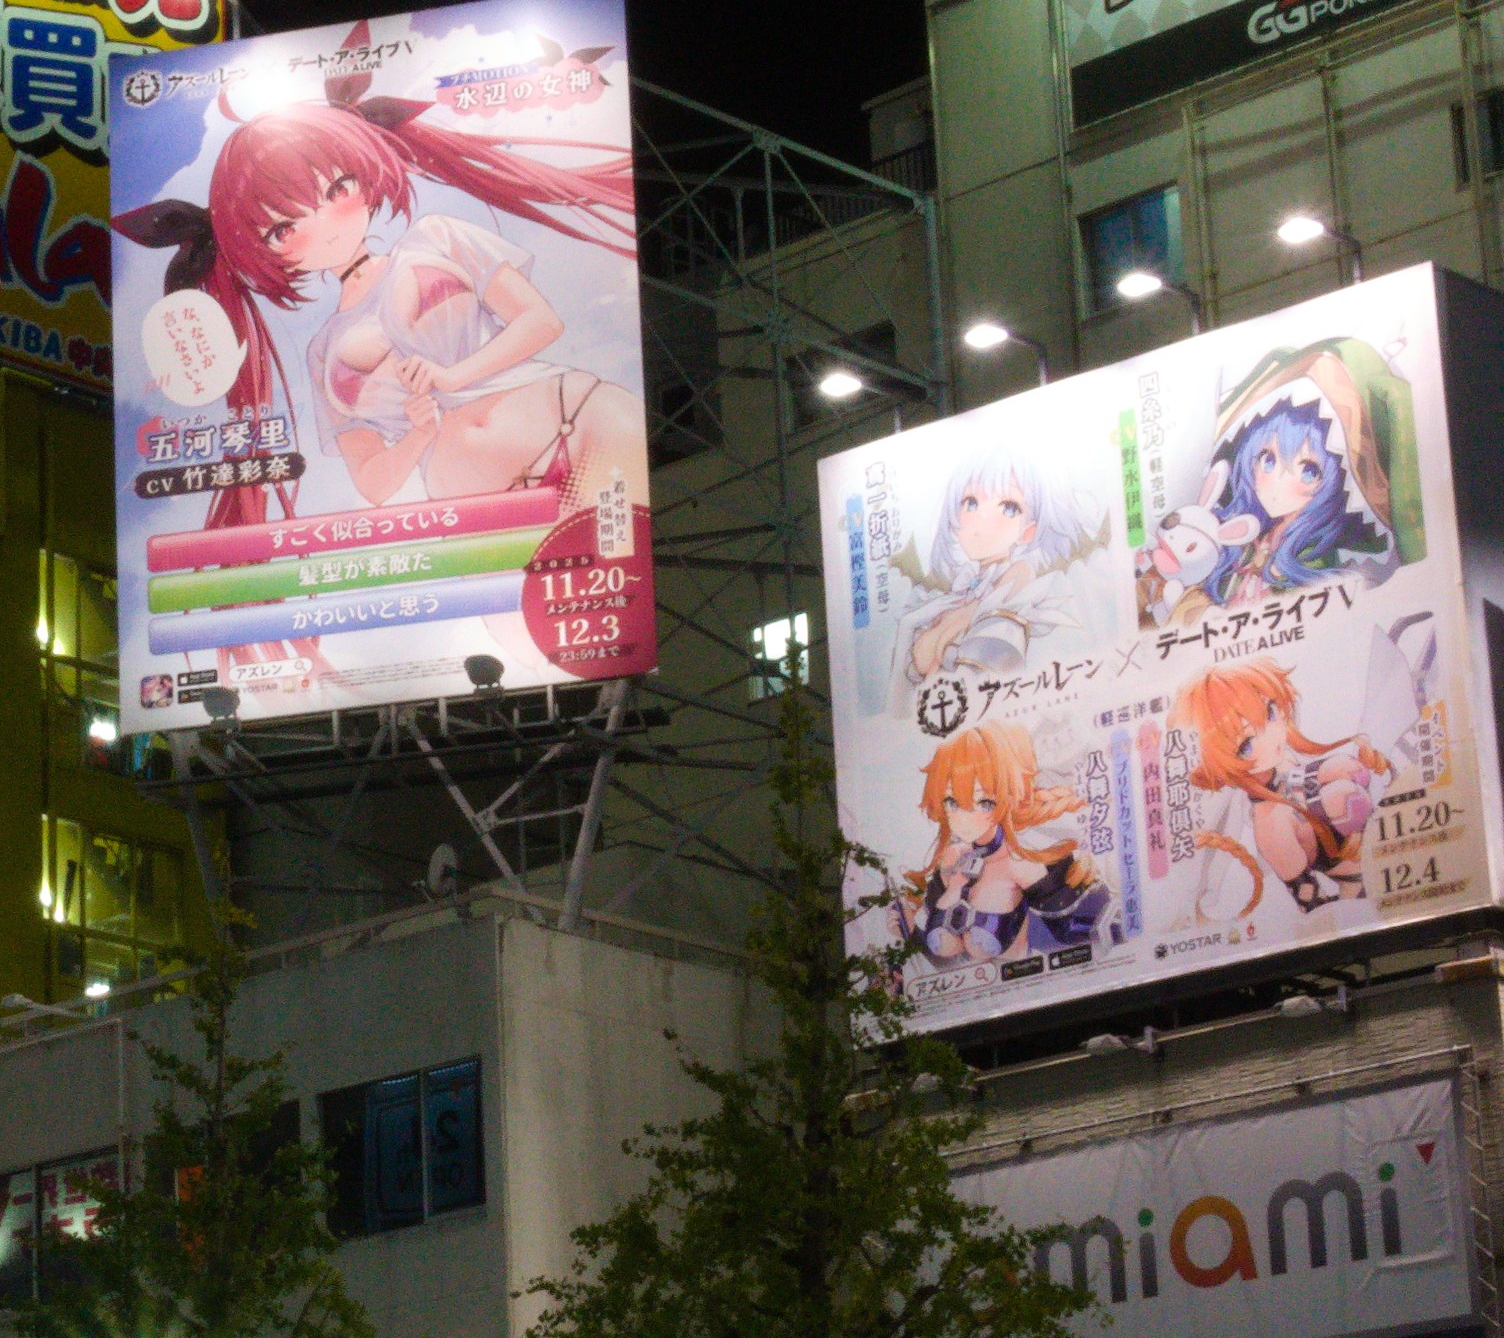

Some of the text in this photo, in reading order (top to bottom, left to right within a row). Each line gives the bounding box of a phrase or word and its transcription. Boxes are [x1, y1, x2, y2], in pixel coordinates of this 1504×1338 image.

[455, 70, 594, 110] 水辺の女神
[148, 416, 291, 461] 五河琴里
[269, 507, 460, 547] すごく似合っている
[292, 593, 440, 632] かわいいと思う
[554, 615, 621, 647] 12.3
[235, 664, 283, 679] アズレン
[978, 660, 1106, 720] アズールレーン
[1382, 857, 1440, 894] 12.4
[1168, 933, 1223, 955] YOSTAR
[917, 974, 966, 997] アズレン
